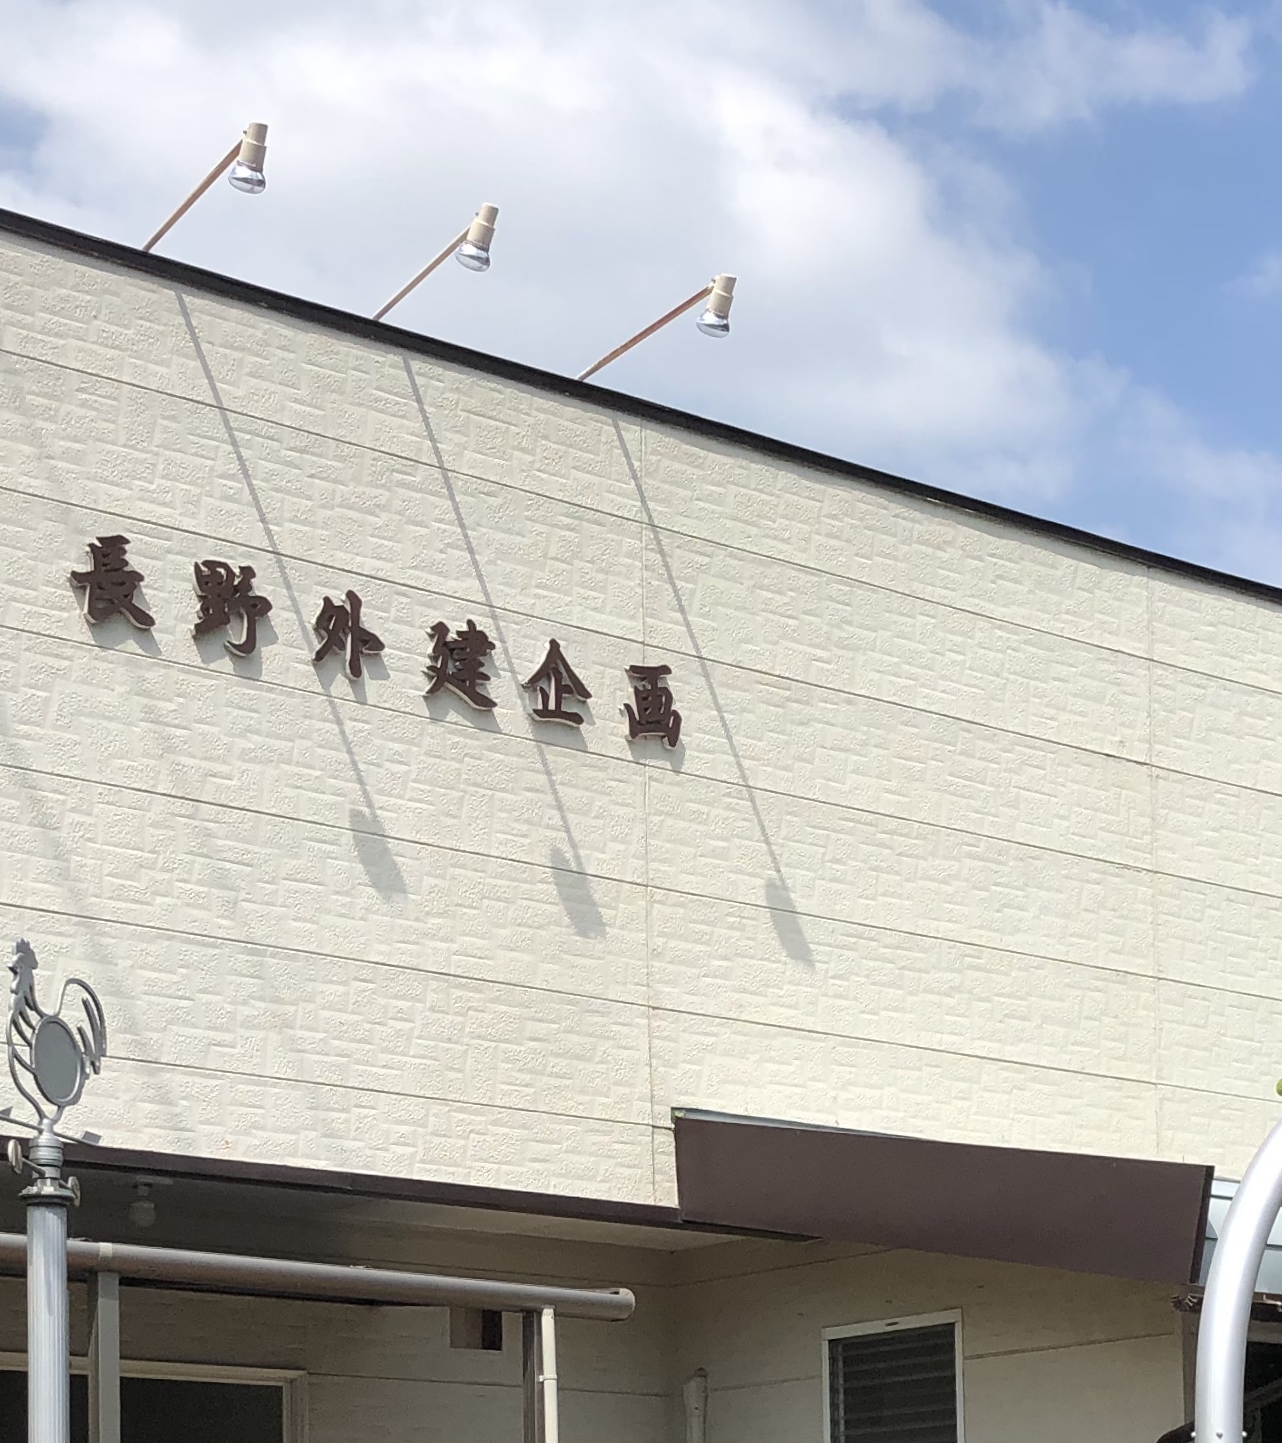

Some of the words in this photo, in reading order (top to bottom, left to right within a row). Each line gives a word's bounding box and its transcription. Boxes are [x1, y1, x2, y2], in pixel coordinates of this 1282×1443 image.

[70, 534, 683, 749] 長野外建企画
